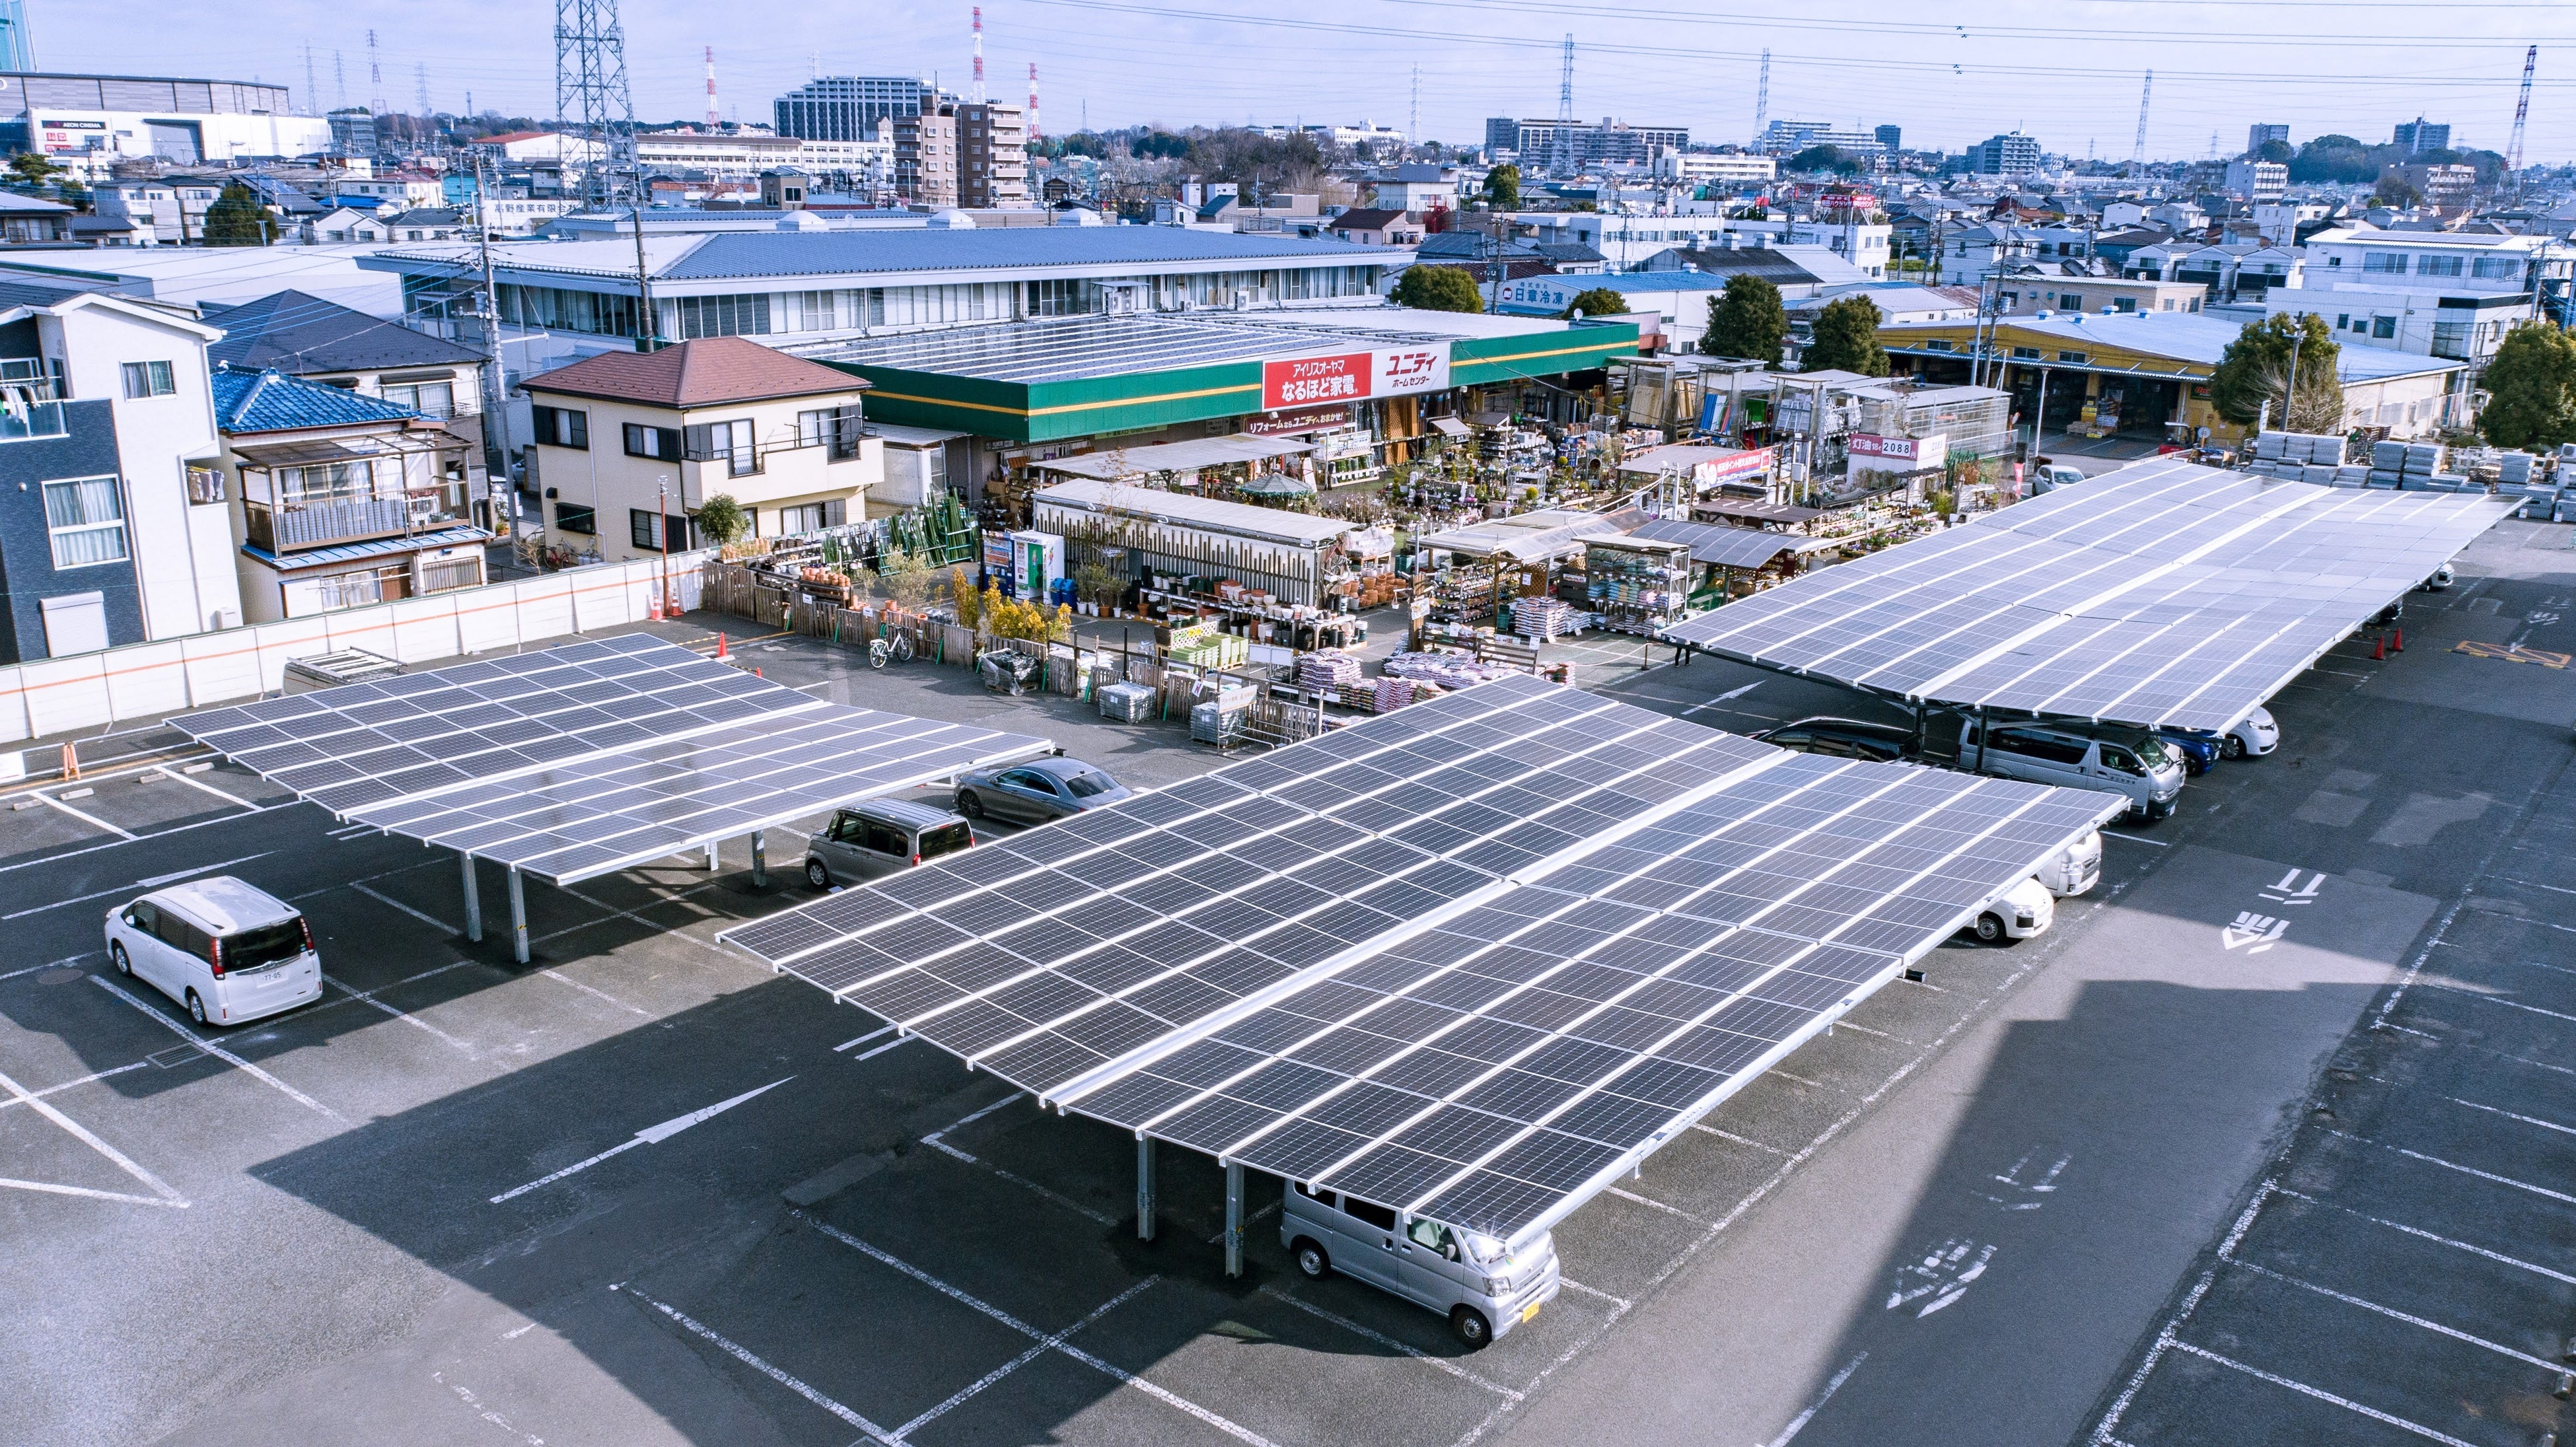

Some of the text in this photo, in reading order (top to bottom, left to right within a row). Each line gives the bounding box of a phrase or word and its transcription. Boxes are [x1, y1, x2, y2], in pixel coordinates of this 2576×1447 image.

[1515, 287, 1563, 305] 日章冷凍
[1293, 359, 1345, 378] アイリスオーヤマ
[1386, 353, 1437, 376] ユニディ
[1392, 376, 1430, 388] ホームセンター
[1883, 442, 1910, 454] 2088
[2222, 868, 2326, 955] 徐行
